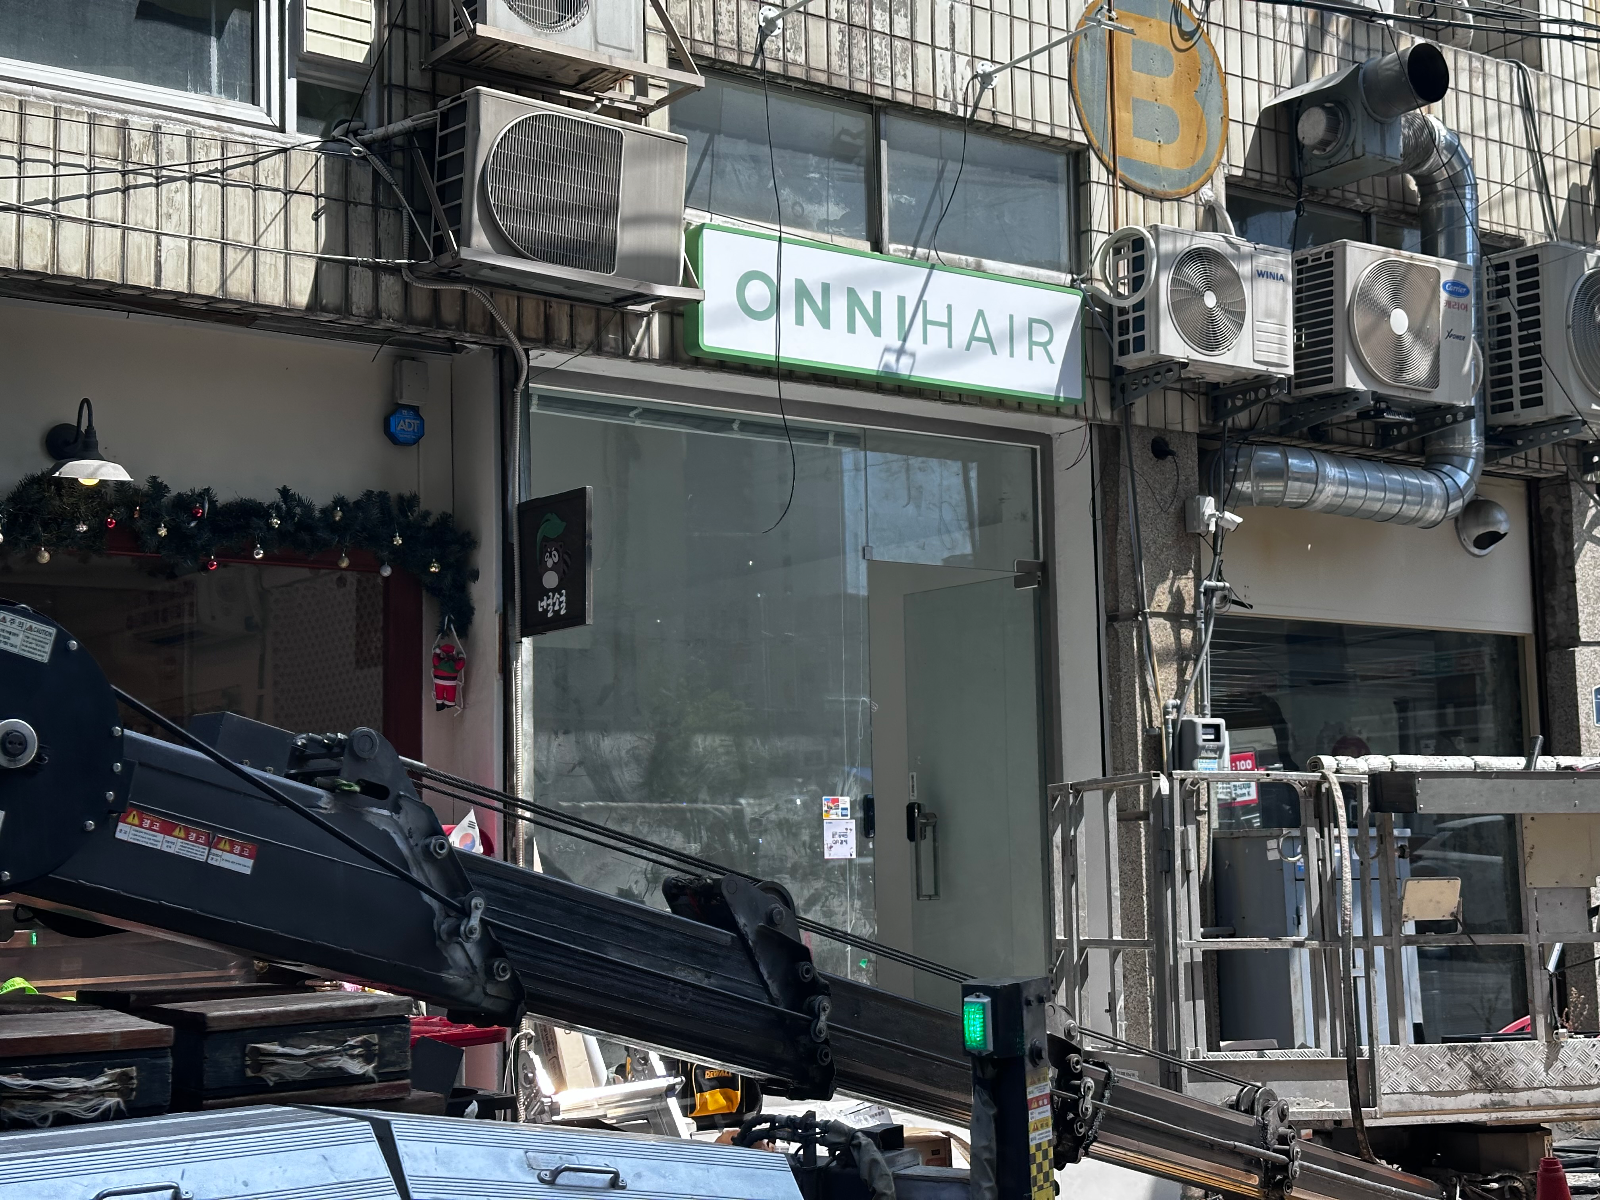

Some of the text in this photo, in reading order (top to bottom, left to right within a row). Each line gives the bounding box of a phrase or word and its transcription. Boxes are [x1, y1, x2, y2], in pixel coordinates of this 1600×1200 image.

[1106, 9, 1207, 171] B
[1256, 269, 1285, 282] WINIA
[1445, 283, 1467, 293] Carrier
[1444, 300, 1468, 312] 캐리어
[397, 419, 420, 432] ADT
[33, 626, 53, 637] CAUTION
